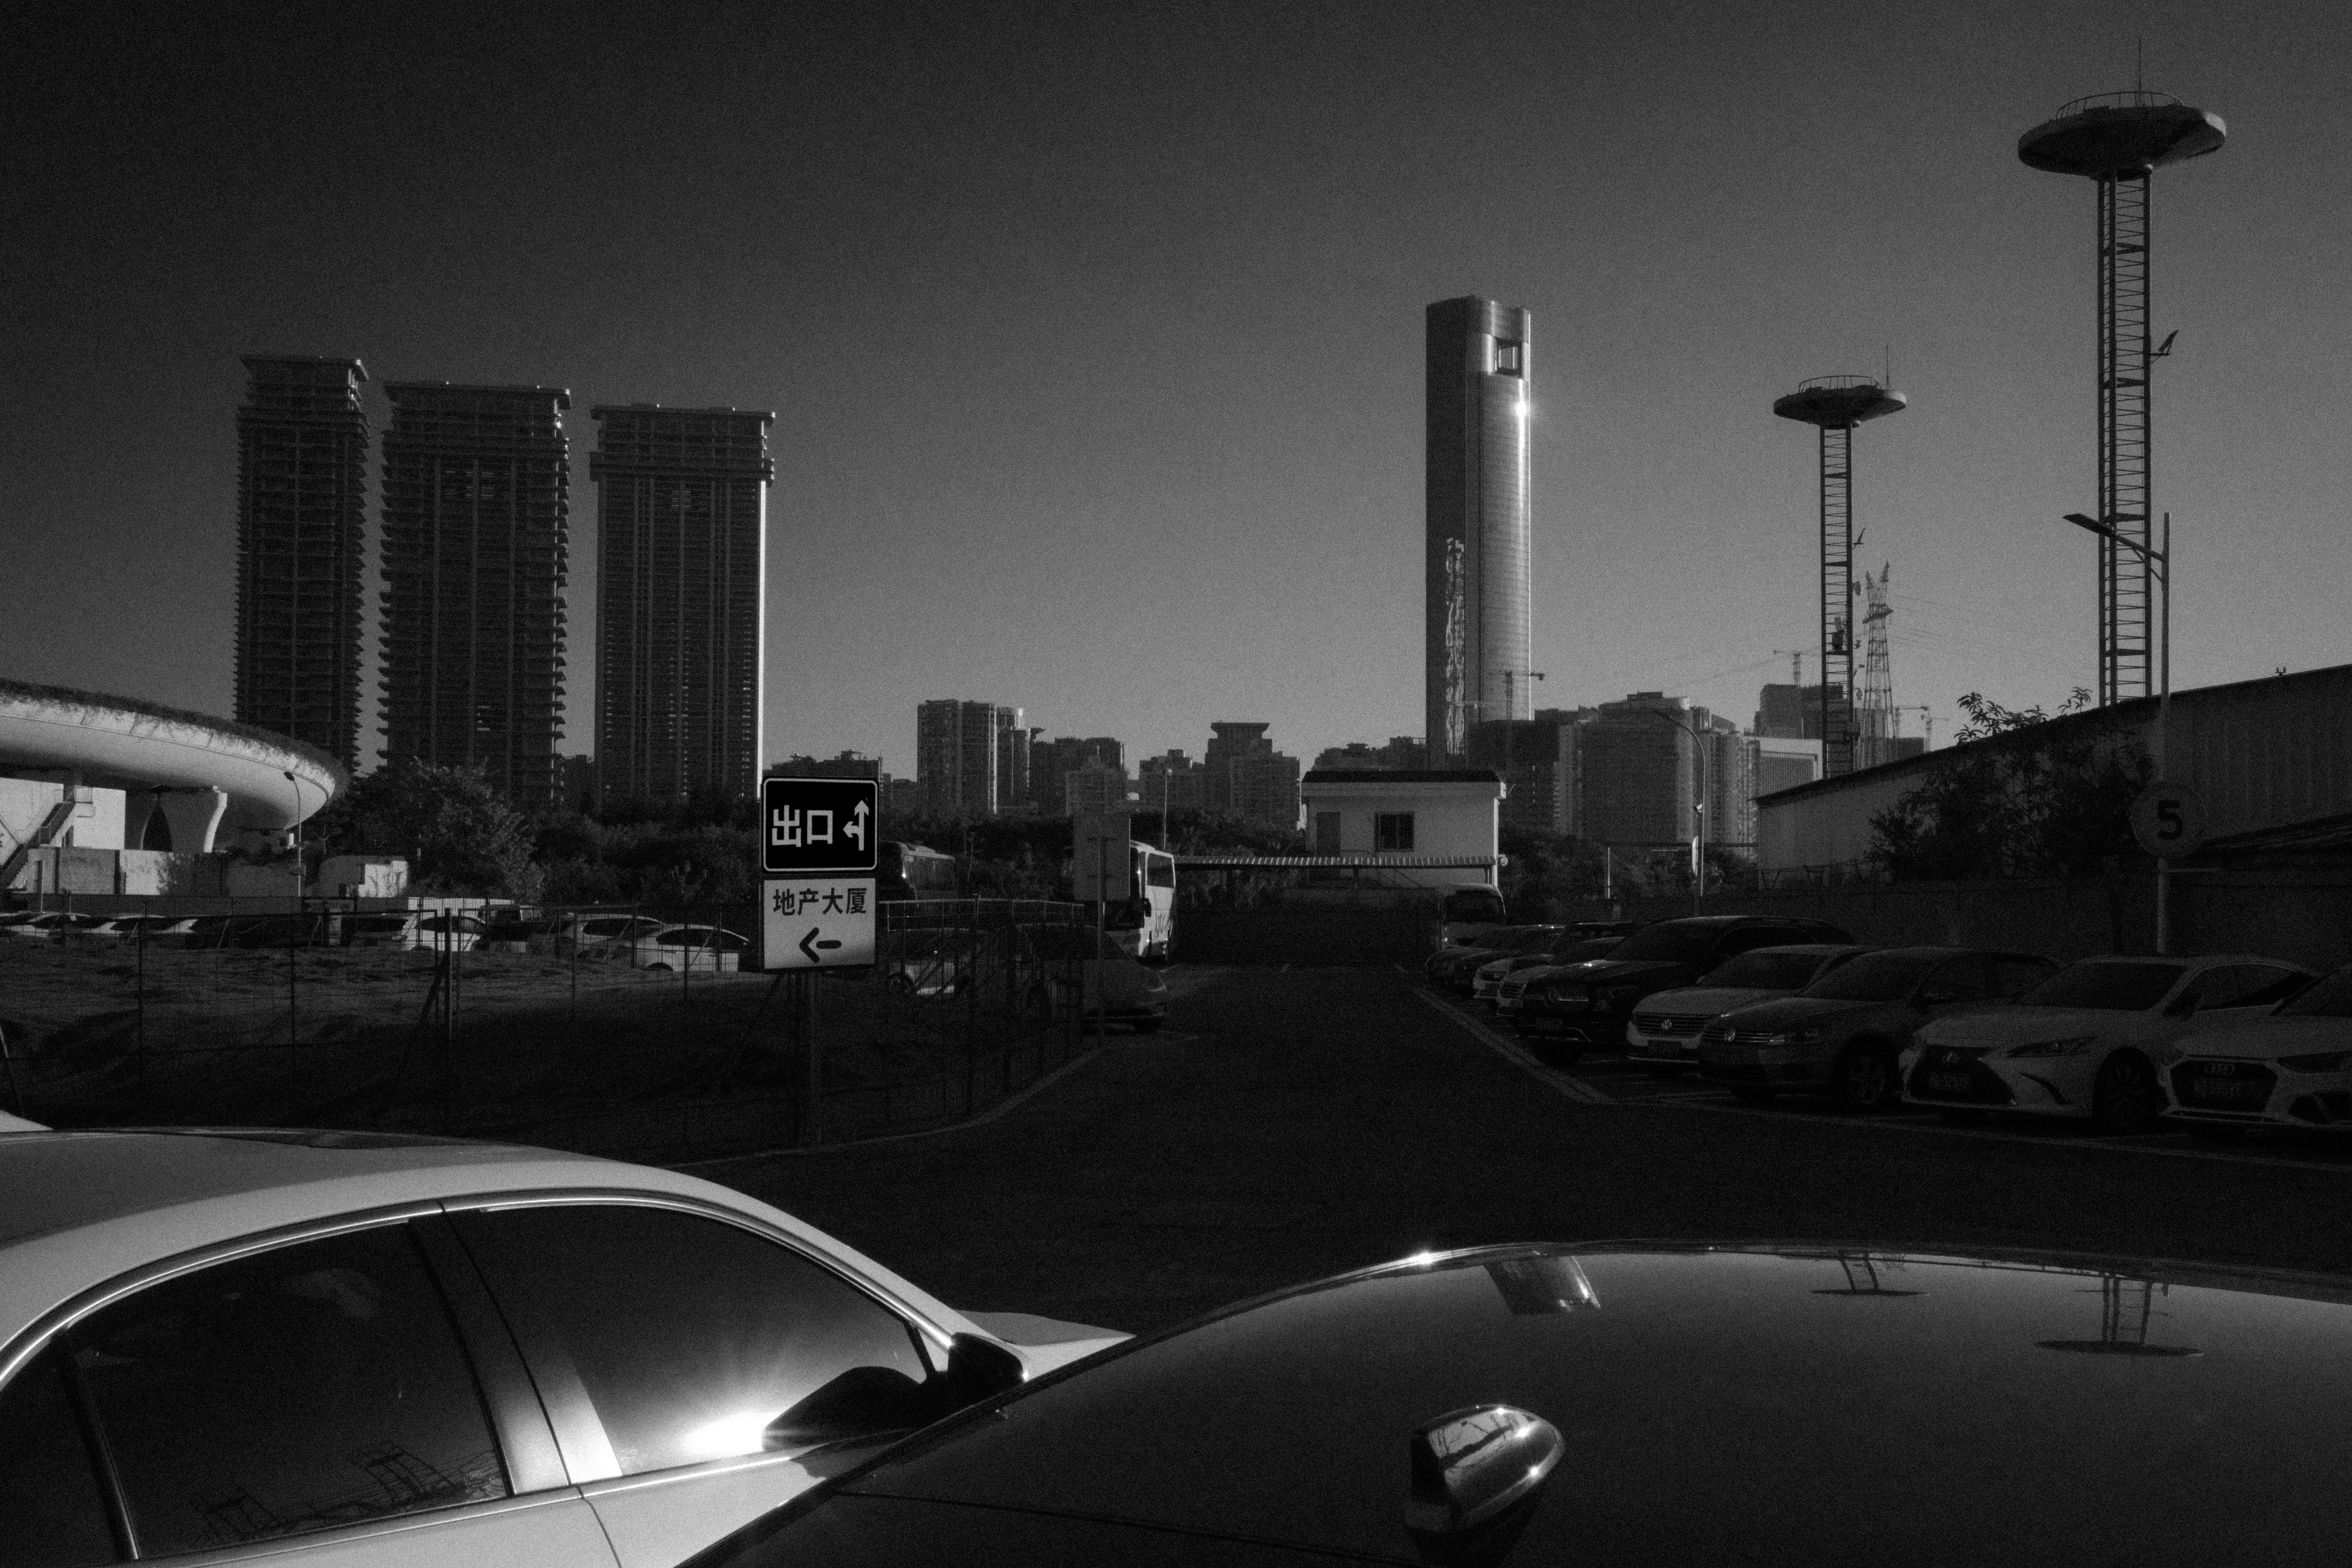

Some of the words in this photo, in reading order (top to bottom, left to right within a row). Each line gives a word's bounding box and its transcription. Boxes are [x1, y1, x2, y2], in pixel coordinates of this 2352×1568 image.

[772, 804, 834, 847] 出口
[2158, 800, 2183, 840] 5
[773, 888, 867, 916] 地产大厦
